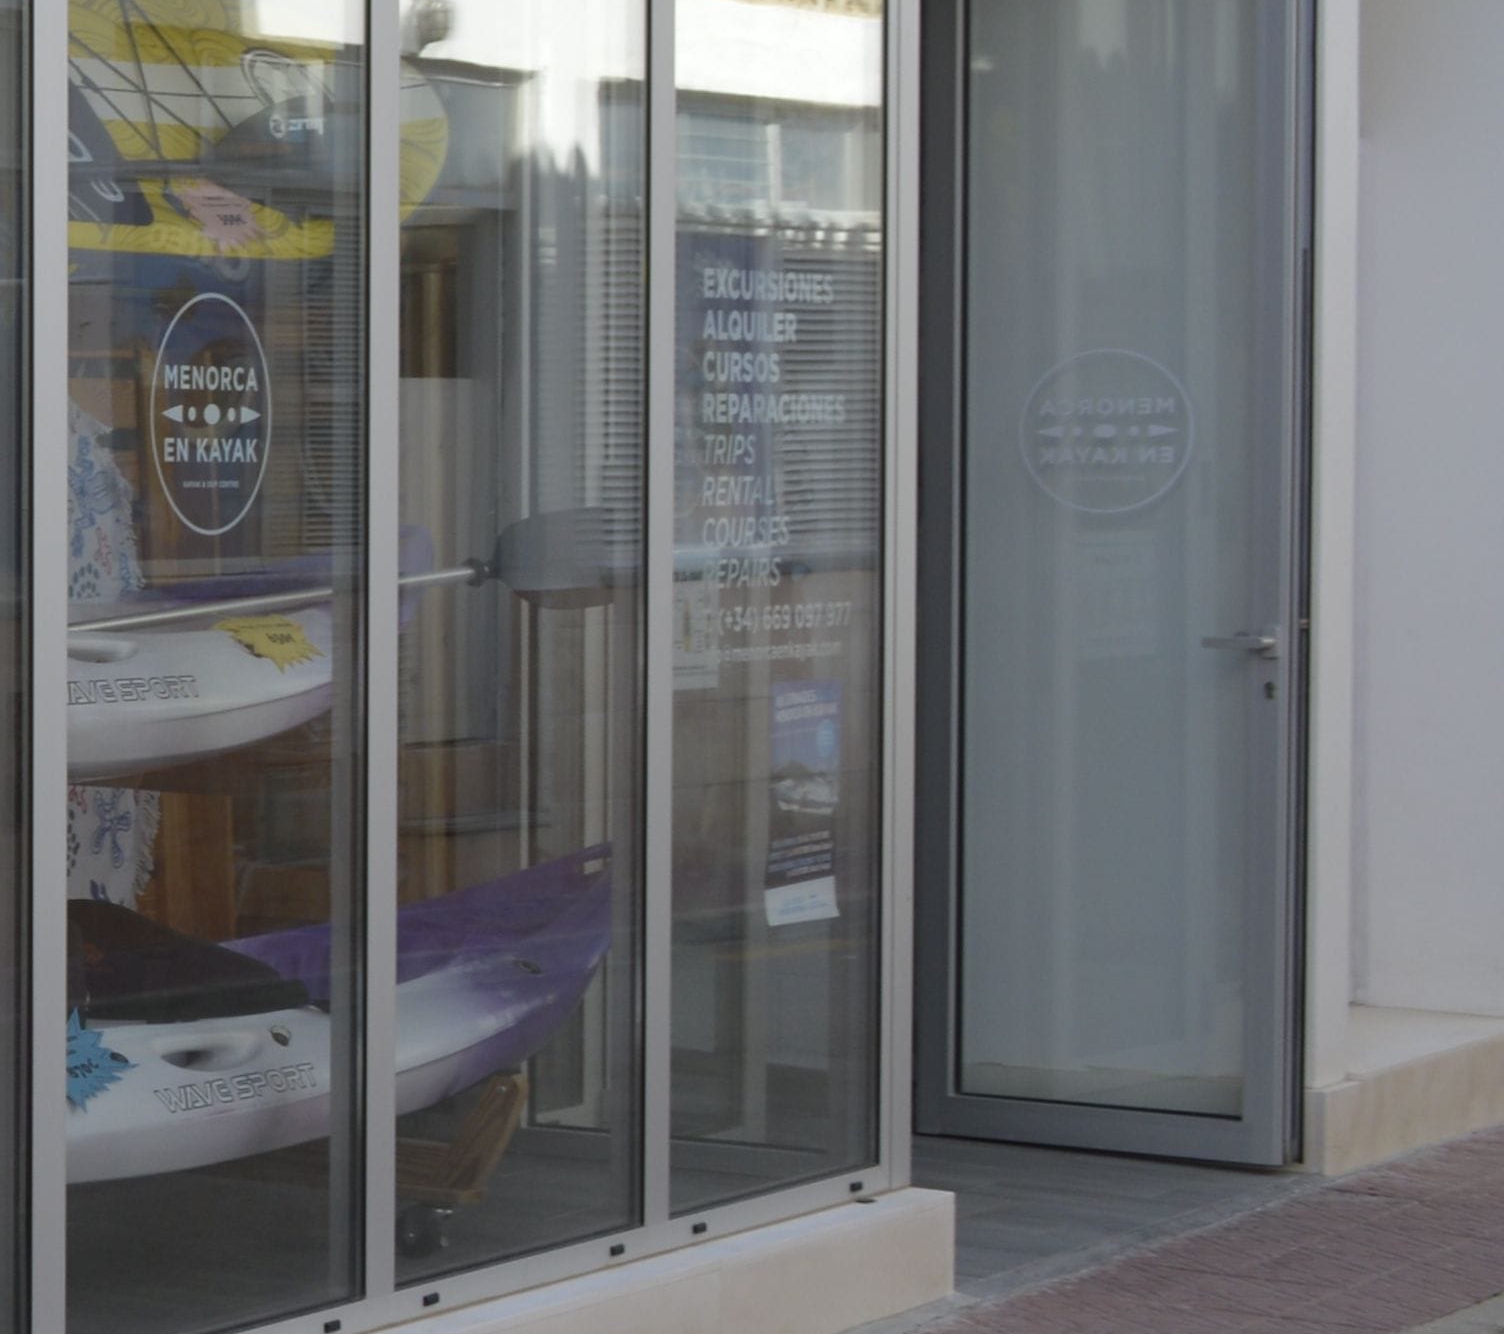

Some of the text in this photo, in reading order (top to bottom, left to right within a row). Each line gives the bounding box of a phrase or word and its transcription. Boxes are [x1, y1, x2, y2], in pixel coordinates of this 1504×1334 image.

[703, 268, 835, 304] EXCURSIONES
[703, 310, 798, 342] ALQUILER
[164, 365, 259, 392] MENORCA
[703, 351, 781, 384] CURSOS
[702, 393, 847, 425] REPARACIONES
[164, 438, 258, 463] EN KAYAK
[705, 435, 756, 465] TRIPS
[702, 475, 776, 507] RENTAL
[703, 516, 789, 548] COURSES
[718, 605, 759, 635] (+34)
[763, 605, 790, 630] 669
[68, 674, 199, 705] AVE SPORT
[153, 1063, 316, 1113] WAVE SPORT
